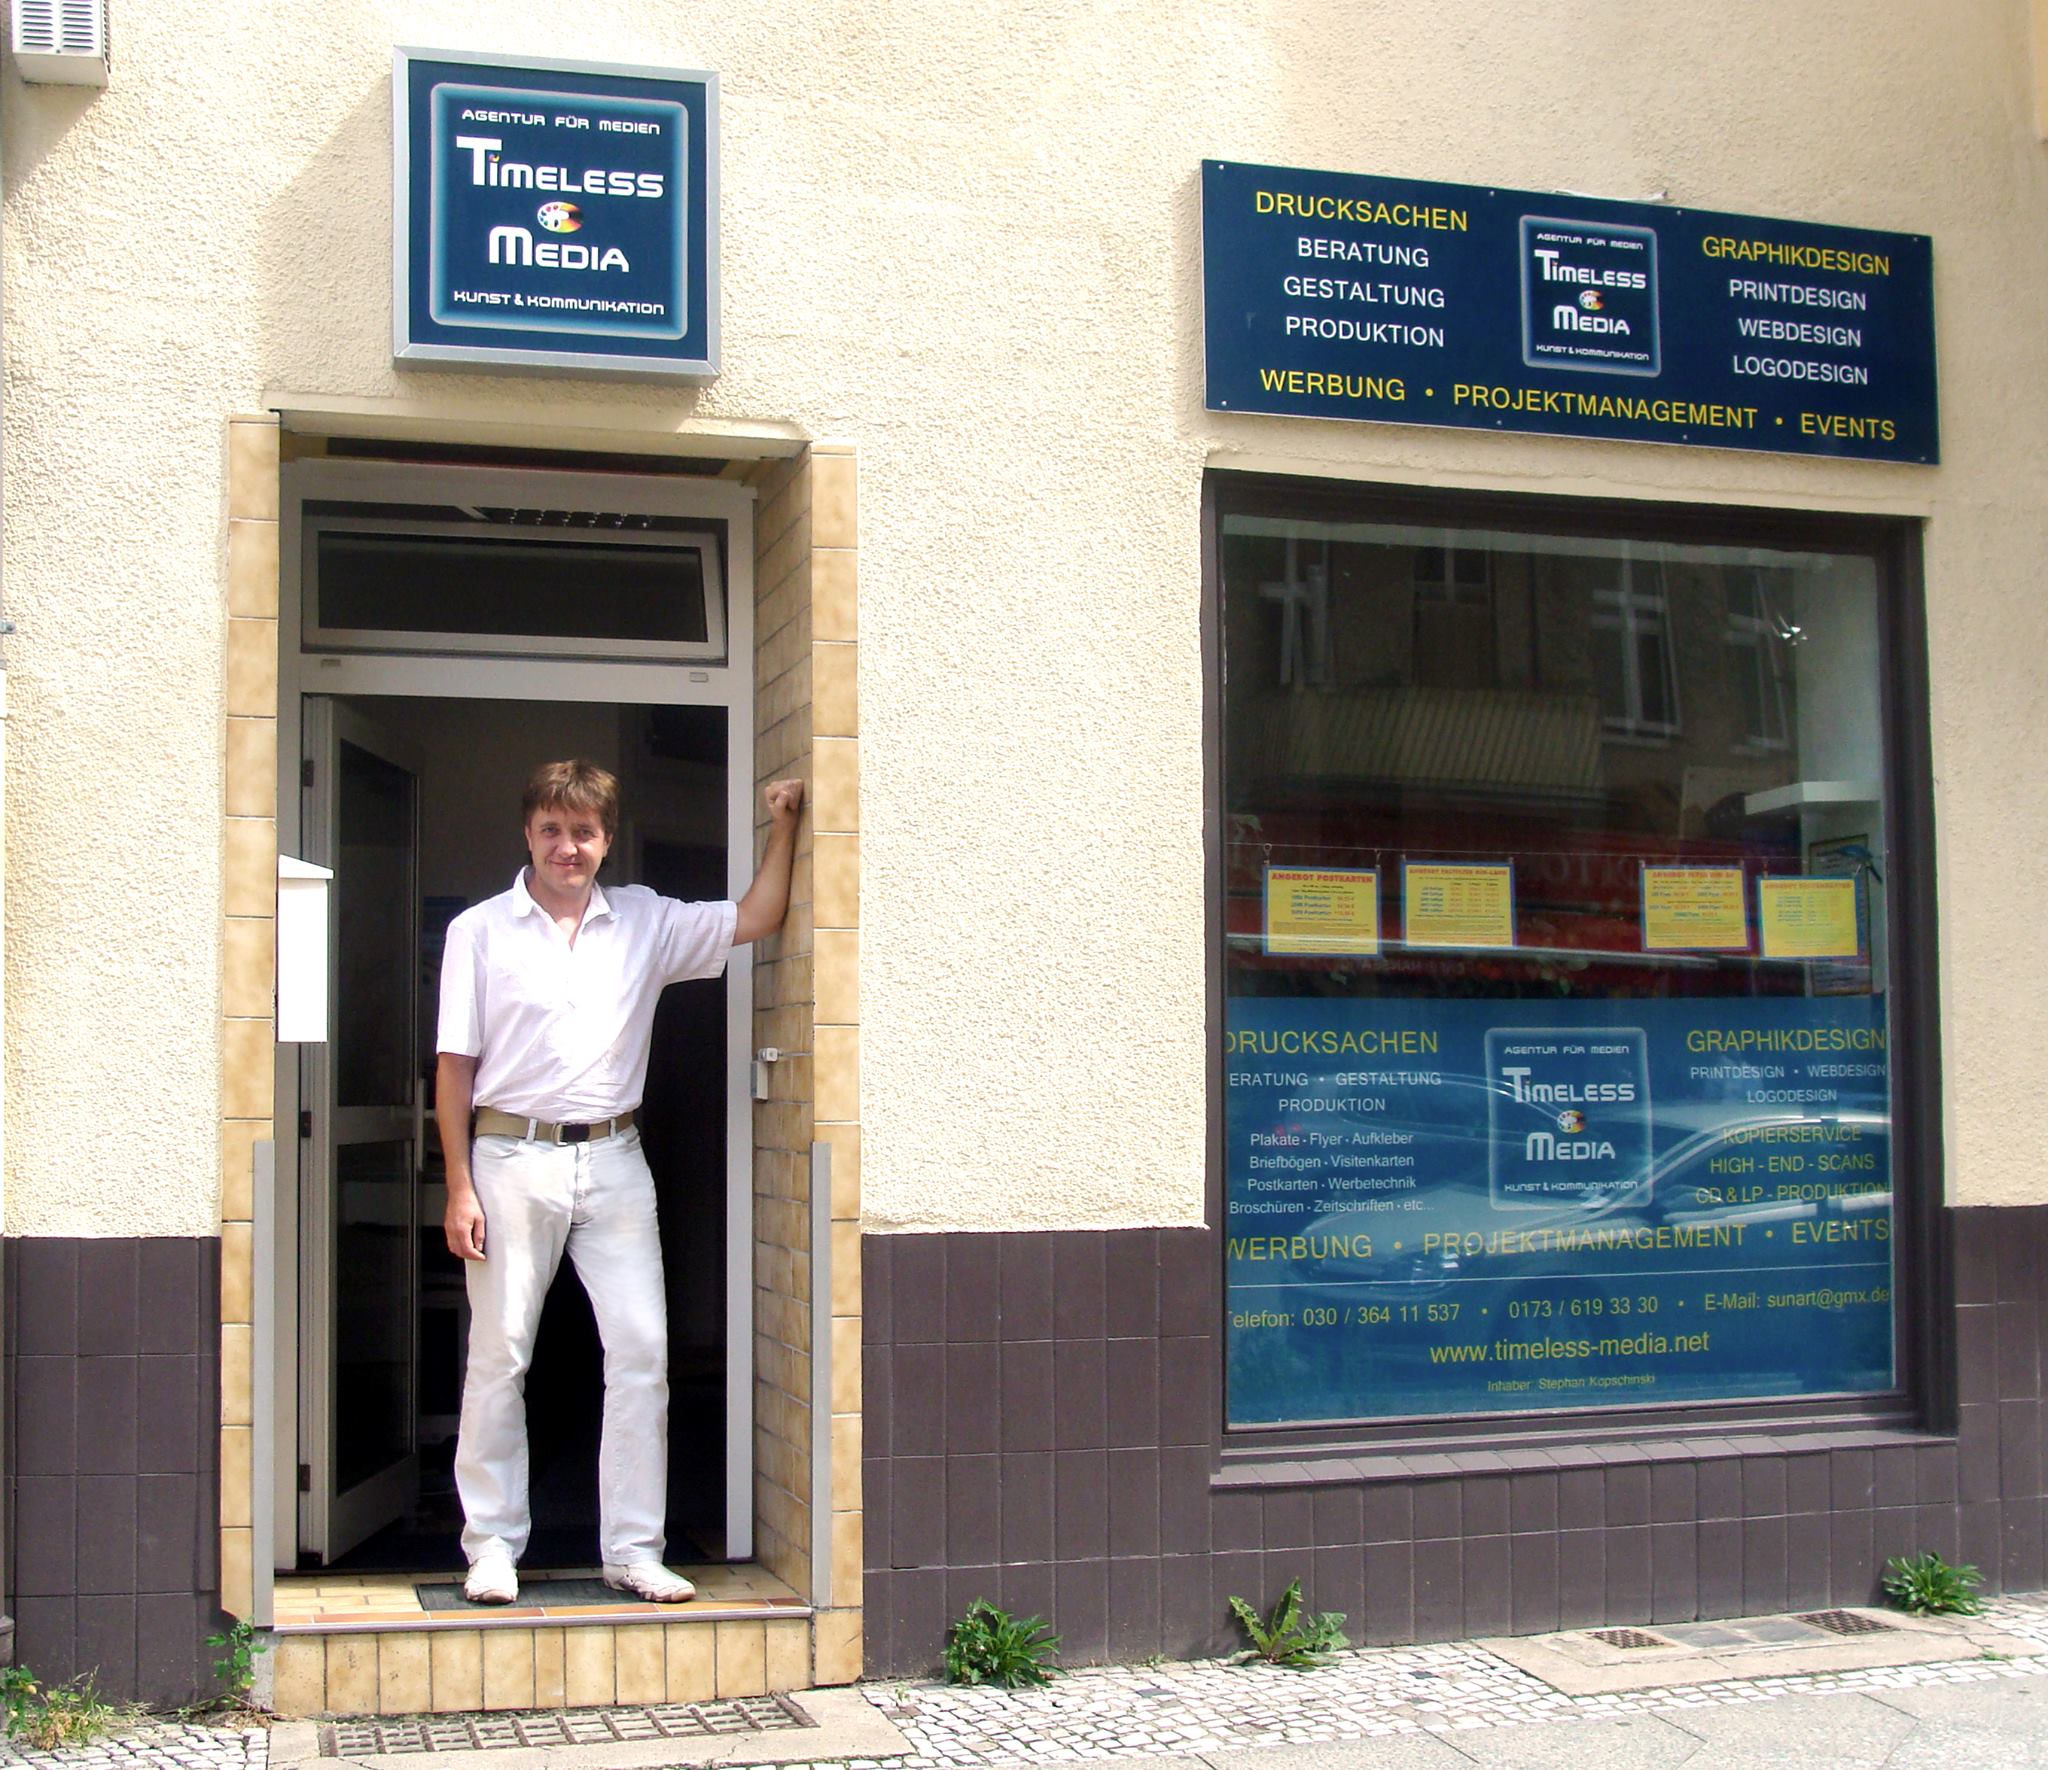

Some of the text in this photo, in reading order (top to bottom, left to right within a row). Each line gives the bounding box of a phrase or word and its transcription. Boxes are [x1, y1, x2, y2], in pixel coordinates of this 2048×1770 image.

[462, 108, 661, 136] AGENTUR FÜR MEDIEN
[1256, 191, 1468, 232] DRUCKSACHEN
[489, 226, 630, 272] MEDIA
[1298, 237, 1429, 268] BERATUNG
[1536, 232, 1583, 245] AGENTUR
[1610, 239, 1644, 251] MEDIEN
[1702, 235, 1890, 276] GRAPHIKDESIGN
[454, 290, 665, 316] KUNST & KOMMUNIKATION
[1283, 276, 1445, 309] GESTALTUNG
[1729, 278, 1867, 312] PRINTDESIGN
[1285, 316, 1445, 348] PRODUKTION
[1553, 304, 1631, 336] MEDIA
[1738, 317, 1862, 348] WEBDESIGN
[1536, 344, 1569, 354] KUNST
[1575, 347, 1650, 361] KOMMUNIKATION
[1733, 355, 1869, 386] LOGODESIGN
[1260, 368, 1897, 441] WERBUNG PROJEKTMANAGEMENT EVENTS
[1504, 1044, 1630, 1055] AGENTUR FÜR MEDIEN
[1686, 1028, 1886, 1052] GRAPHIKDESIGN
[1229, 1071, 1442, 1087] ERATUNG GESTALTUNG
[1690, 1064, 1886, 1080] PRINTDESIGN WEBDESIGN
[1279, 1098, 1385, 1113] PRODUKTION
[1747, 1089, 1838, 1104] LOGODESIGN
[1250, 1132, 1414, 1150] Plakate Flyer Aufkleber
[1526, 1132, 1616, 1161] MEDIA
[1723, 1125, 1862, 1145] KOPIERSERVICE
[1250, 1153, 1414, 1173] Briefbögen Visitenkarten
[1710, 1157, 1754, 1174] HIGH
[1769, 1156, 1805, 1173] END
[1818, 1153, 1875, 1171] SCANS
[1247, 1175, 1417, 1192] Postkarten Werbetechnik
[1505, 1182, 1541, 1192] KUNST
[1551, 1180, 1638, 1192] KOMMUNIKATION
[1696, 1187, 1722, 1204] CD
[1726, 1186, 1738, 1203] &
[1742, 1185, 1763, 1202] LP
[1777, 1181, 1888, 1201] PRODUKTION
[1229, 1200, 1304, 1215] Broschüren
[1314, 1199, 1394, 1213] Zeitschriften
[1424, 1222, 1747, 1255] PROJEKTMANAGEMENT
[1792, 1218, 1890, 1245] EVENTS
[1228, 1308, 1295, 1329] elefon:
[1303, 1307, 1338, 1326] 030
[1358, 1306, 1391, 1324] 364
[1400, 1305, 1420, 1322] 11
[1428, 1303, 1461, 1322] 537
[1508, 1300, 1552, 1319] 0173
[1570, 1298, 1603, 1317] 619
[1610, 1297, 1631, 1315] 33
[1637, 1296, 1658, 1314] 30
[1705, 1291, 1761, 1311] E-Mail:
[1430, 1331, 1710, 1363] www.timeless-media.net
[1538, 1378, 1585, 1391] Stephan
